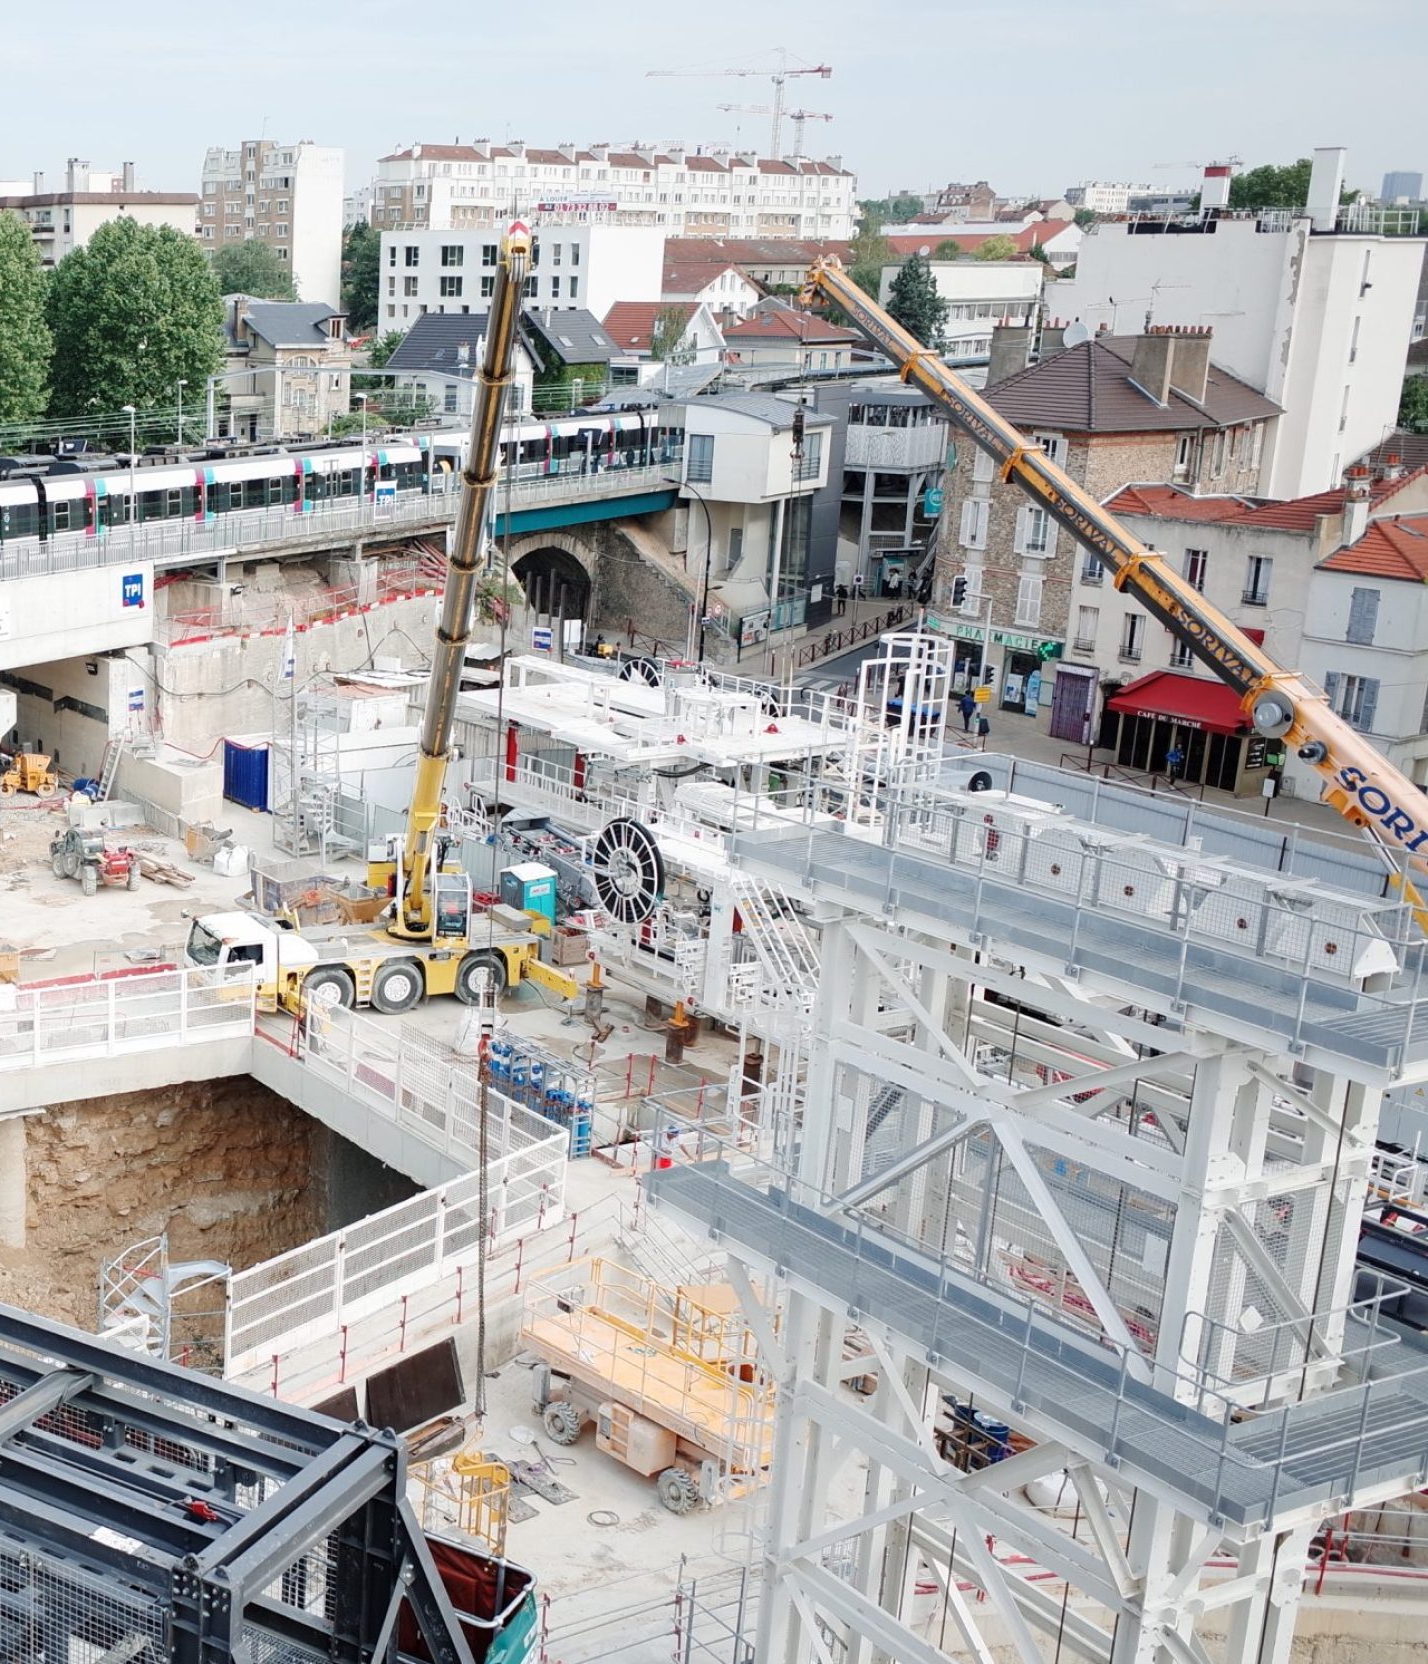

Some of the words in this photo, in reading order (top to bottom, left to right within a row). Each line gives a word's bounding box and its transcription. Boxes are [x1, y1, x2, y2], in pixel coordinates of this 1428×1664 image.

[1057, 499, 1118, 556] SORIVAL
[124, 583, 141, 598] TPI
[956, 625, 1039, 650] PHAMACIE
[1176, 610, 1256, 689] SORIVAL
